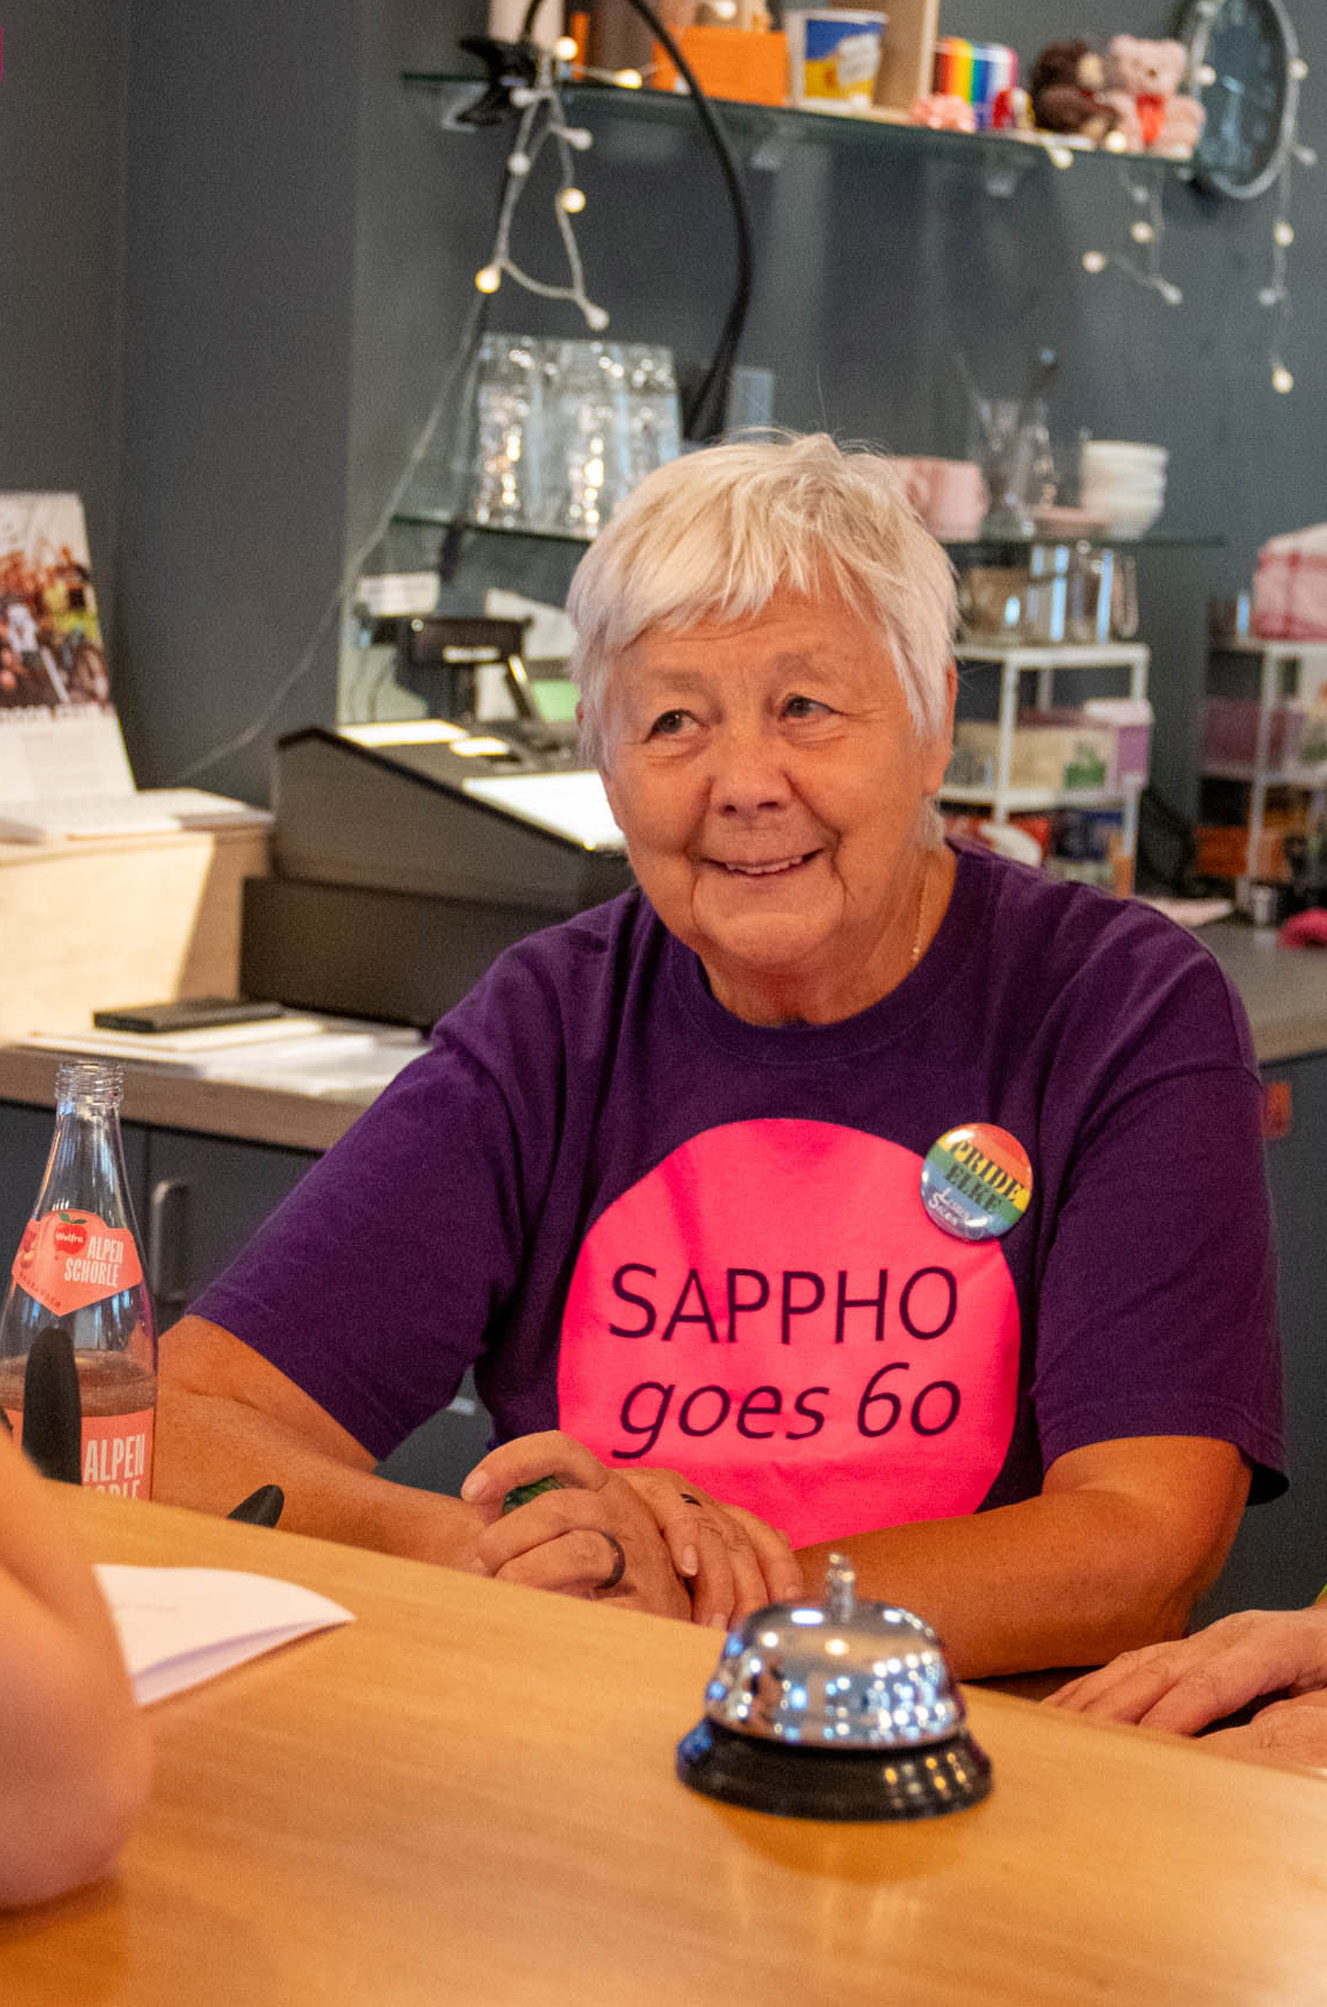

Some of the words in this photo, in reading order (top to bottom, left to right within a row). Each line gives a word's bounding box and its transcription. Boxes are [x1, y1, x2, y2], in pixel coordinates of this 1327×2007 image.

[950, 1141, 1024, 1203] PRIDE
[64, 1257, 120, 1288] SCHORLE
[87, 1235, 125, 1264] ALPEN
[608, 1262, 958, 1345] SAPPHO
[611, 1380, 830, 1460] goes
[856, 1361, 962, 1439] 60
[83, 1433, 146, 1482] ALPEN
